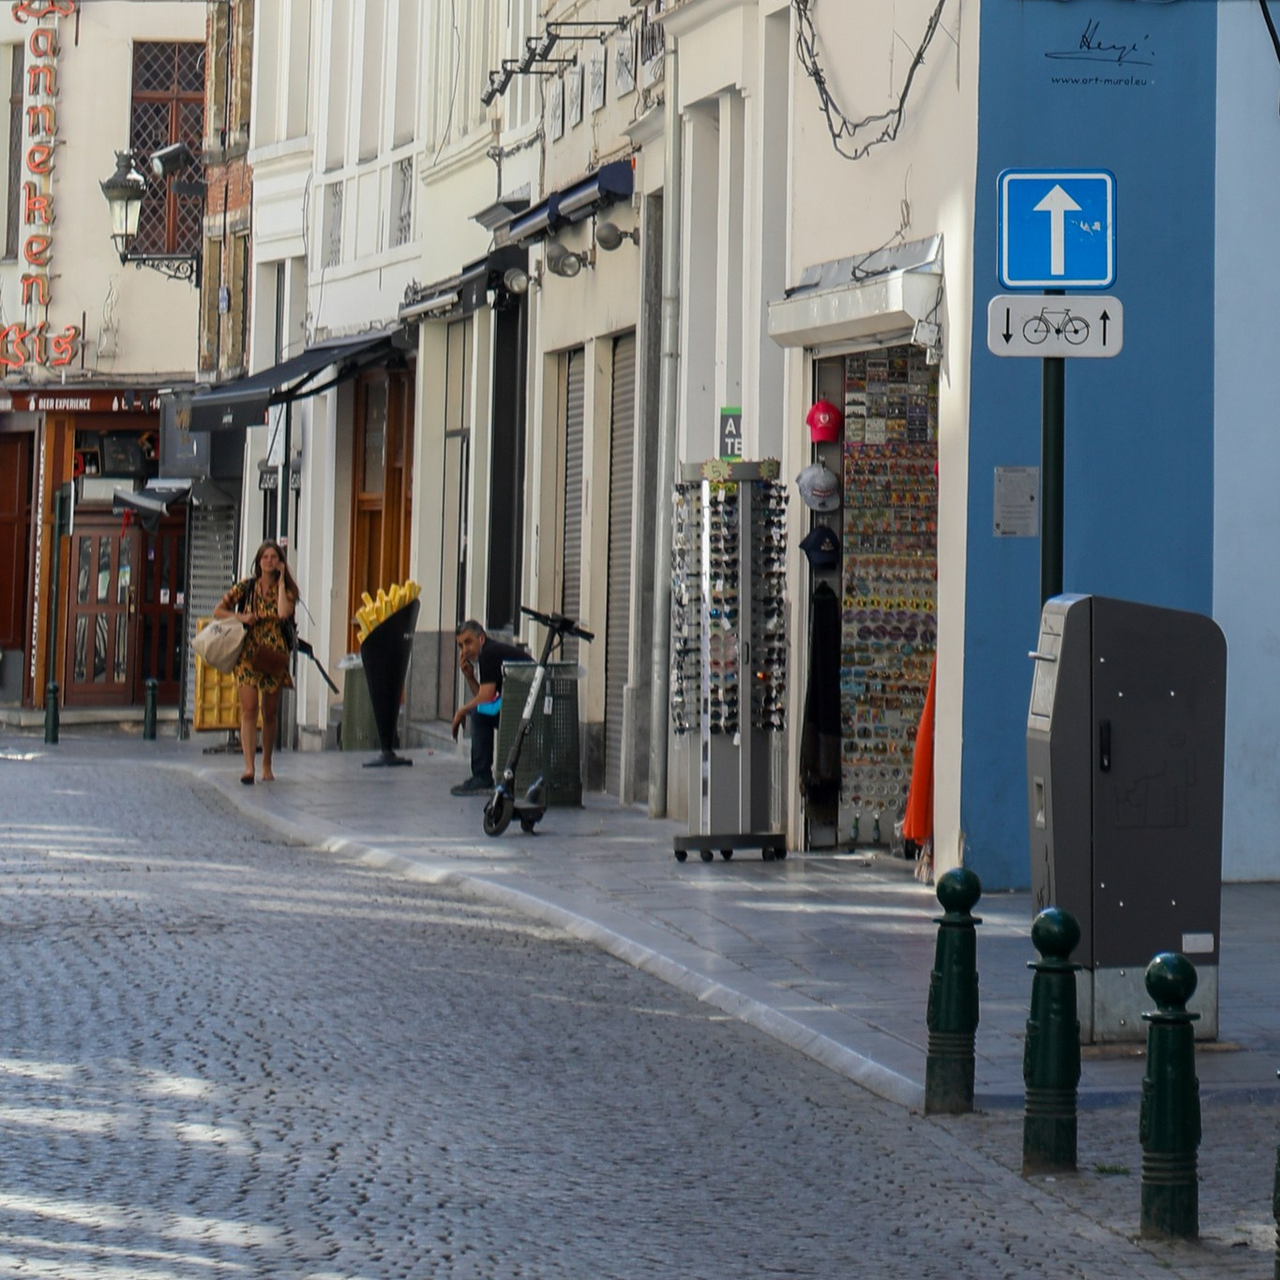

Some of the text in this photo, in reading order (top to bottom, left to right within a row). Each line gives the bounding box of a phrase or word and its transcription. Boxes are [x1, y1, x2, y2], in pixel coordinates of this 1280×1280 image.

[1051, 76, 1148, 87] www.art-mural.eu
[38, 397, 91, 411] BEER EXPERIENCE
